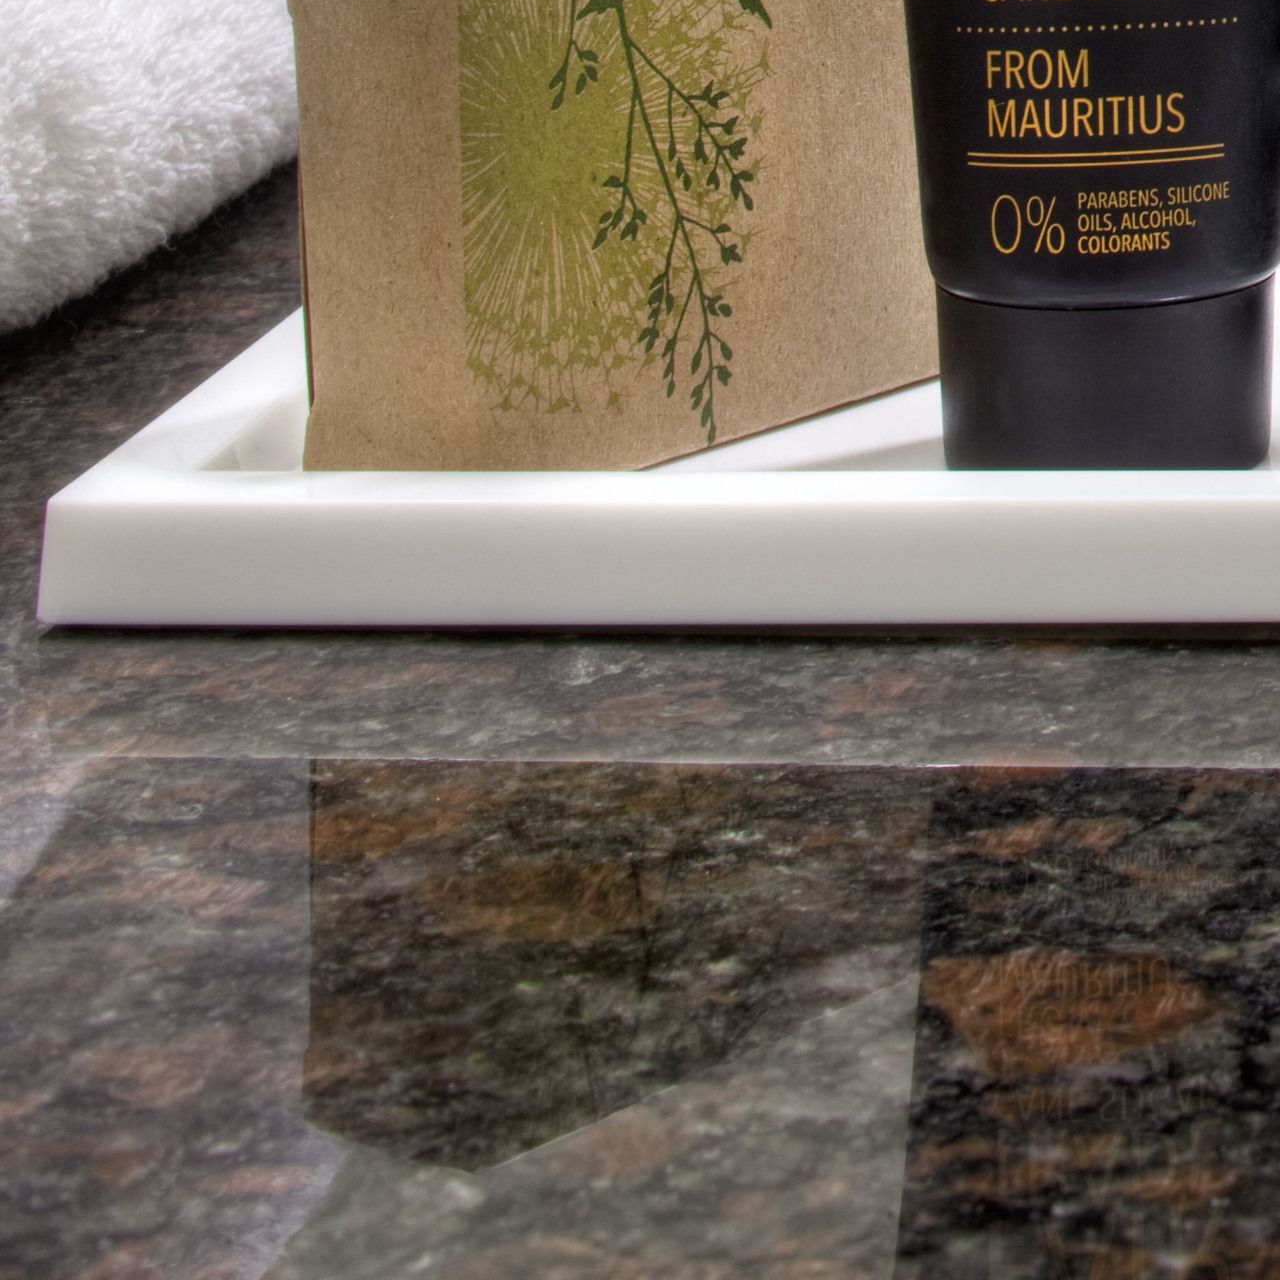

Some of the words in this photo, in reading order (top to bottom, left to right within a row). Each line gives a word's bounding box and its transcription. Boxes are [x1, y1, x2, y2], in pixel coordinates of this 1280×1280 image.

[987, 49, 1088, 89] FROM
[988, 93, 1184, 138] MAURITIUS
[992, 195, 1065, 254] 0%
[1078, 189, 1162, 208] PARABENS,
[1168, 181, 1229, 205] SILICONE
[1078, 214, 1116, 232] OILS,
[1121, 209, 1195, 229] ALCOHOL,
[1078, 232, 1170, 254] COLORANTS
